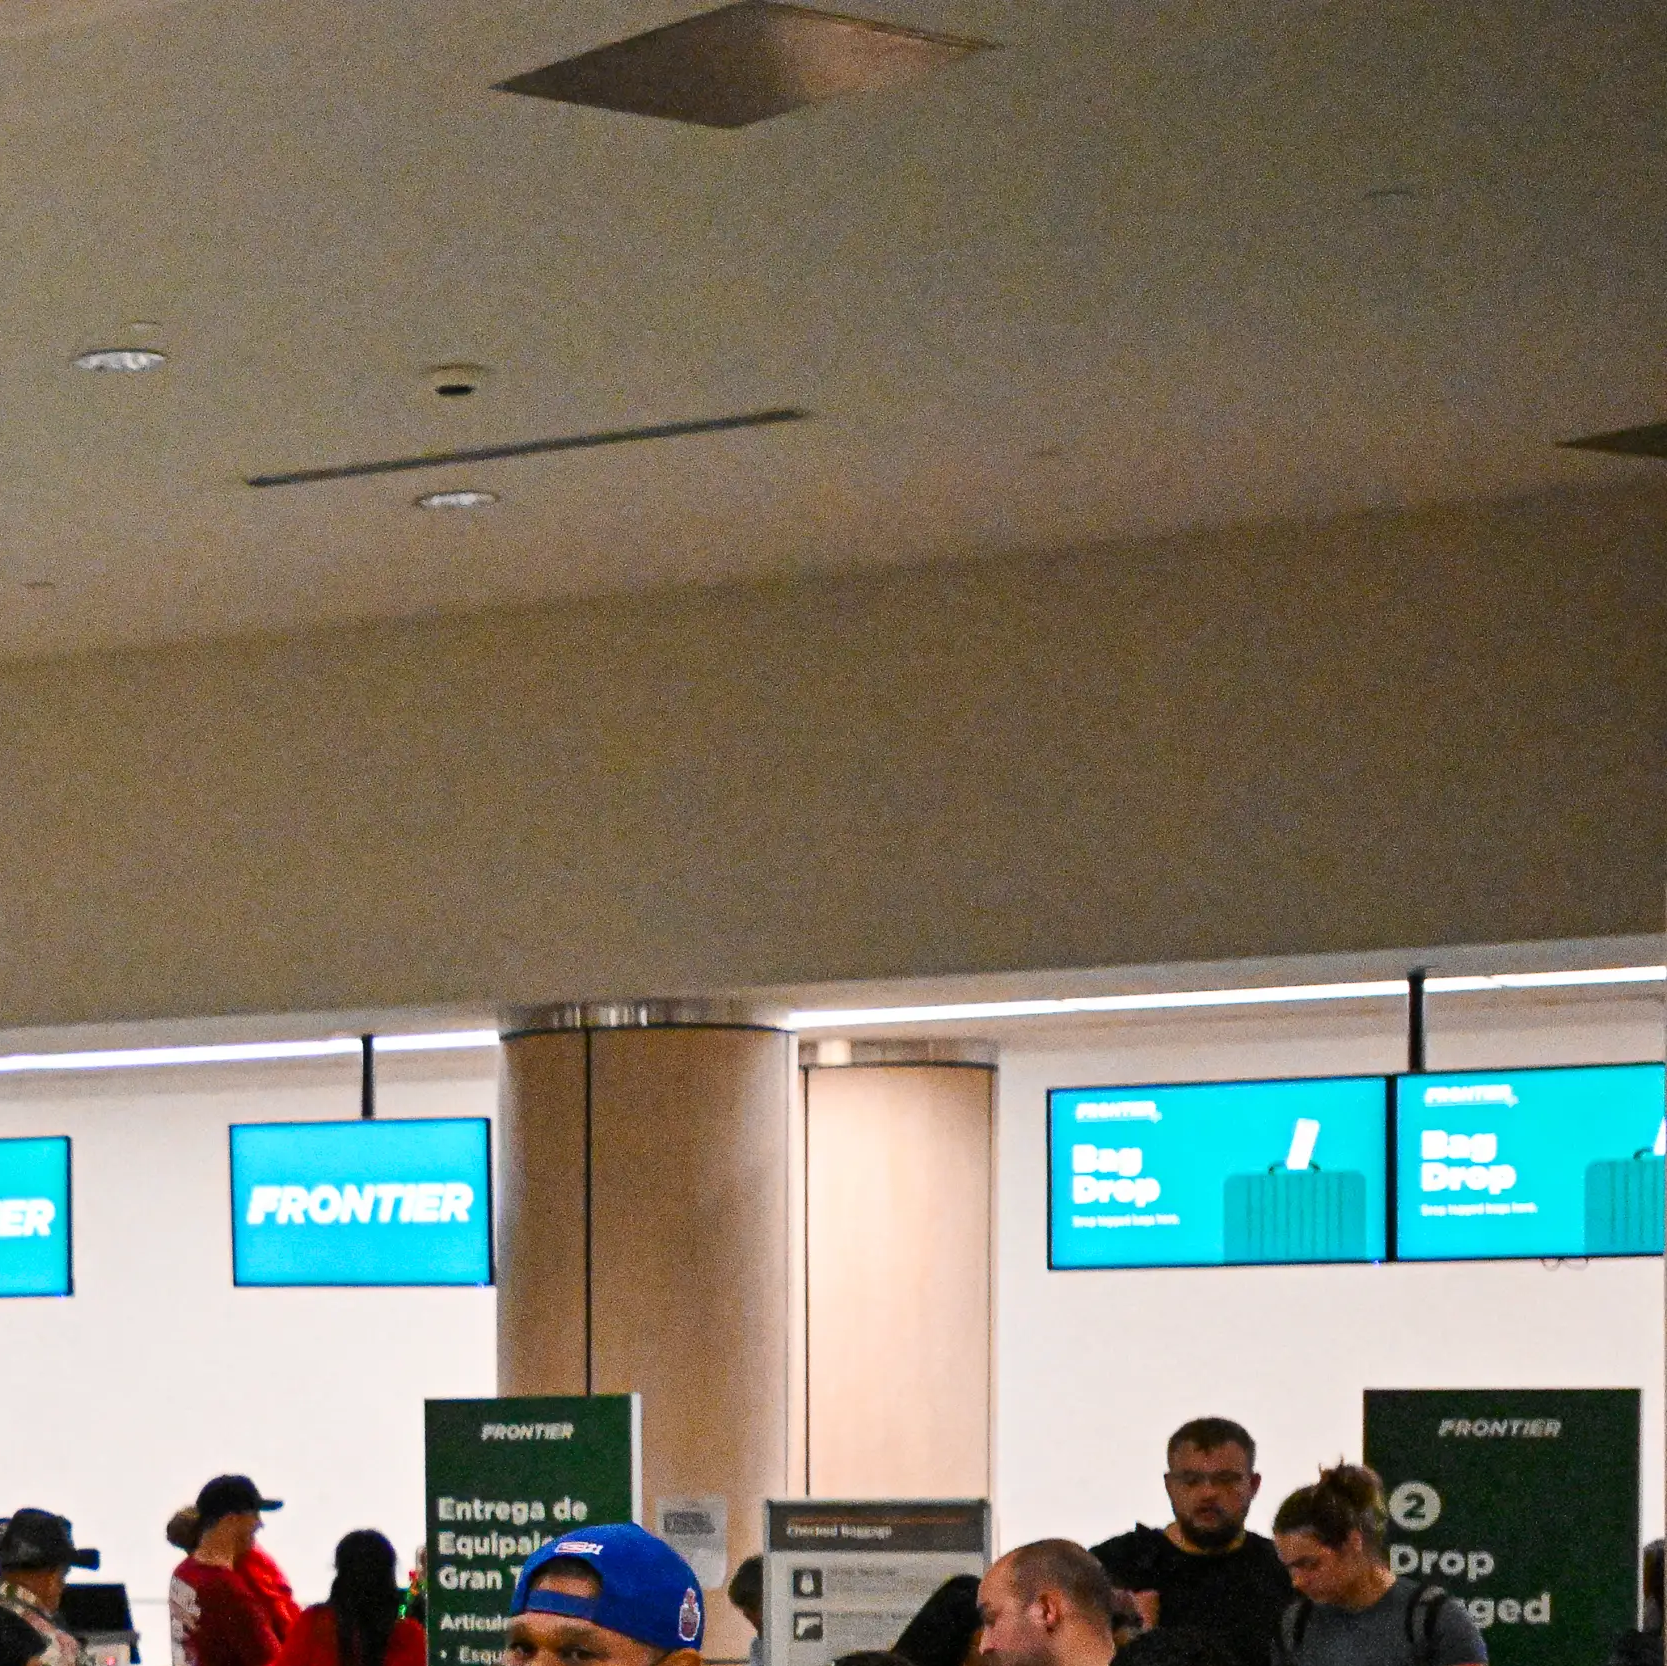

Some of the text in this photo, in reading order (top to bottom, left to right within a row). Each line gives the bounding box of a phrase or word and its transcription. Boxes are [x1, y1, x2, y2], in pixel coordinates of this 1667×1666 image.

[1072, 1144, 1142, 1177] Bag
[1421, 1130, 1497, 1164] Bag
[1072, 1175, 1161, 1208] Drop
[1421, 1162, 1517, 1195] Drop
[246, 1182, 474, 1224] FRONTIER
[481, 1422, 575, 1441] FRONTIER
[1437, 1418, 1562, 1438] FRONTIER
[438, 1495, 588, 1526] Entrega de
[1402, 1490, 1427, 1519] 2
[438, 1564, 503, 1590] Gran
[1389, 1544, 1495, 1583] Drop
